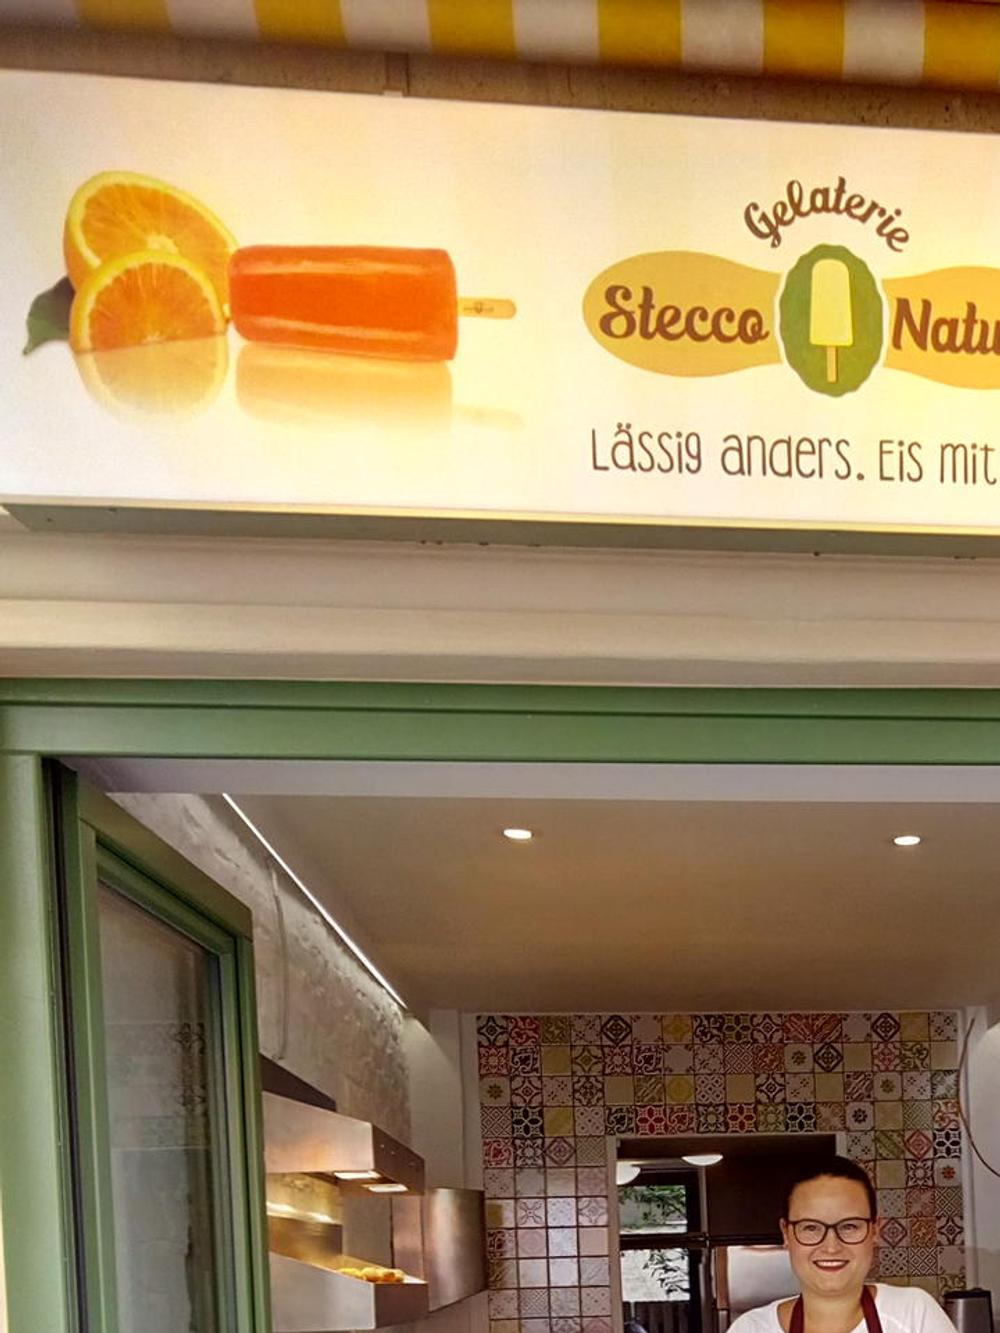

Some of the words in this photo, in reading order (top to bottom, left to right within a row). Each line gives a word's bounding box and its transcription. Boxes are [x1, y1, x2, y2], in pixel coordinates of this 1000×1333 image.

[744, 176, 910, 253] Gelaterie
[599, 285, 770, 344] Stecco
[592, 422, 701, 475] Lässig
[720, 433, 866, 481] anders.
[878, 440, 923, 483] Eis
[940, 443, 997, 487] mit
